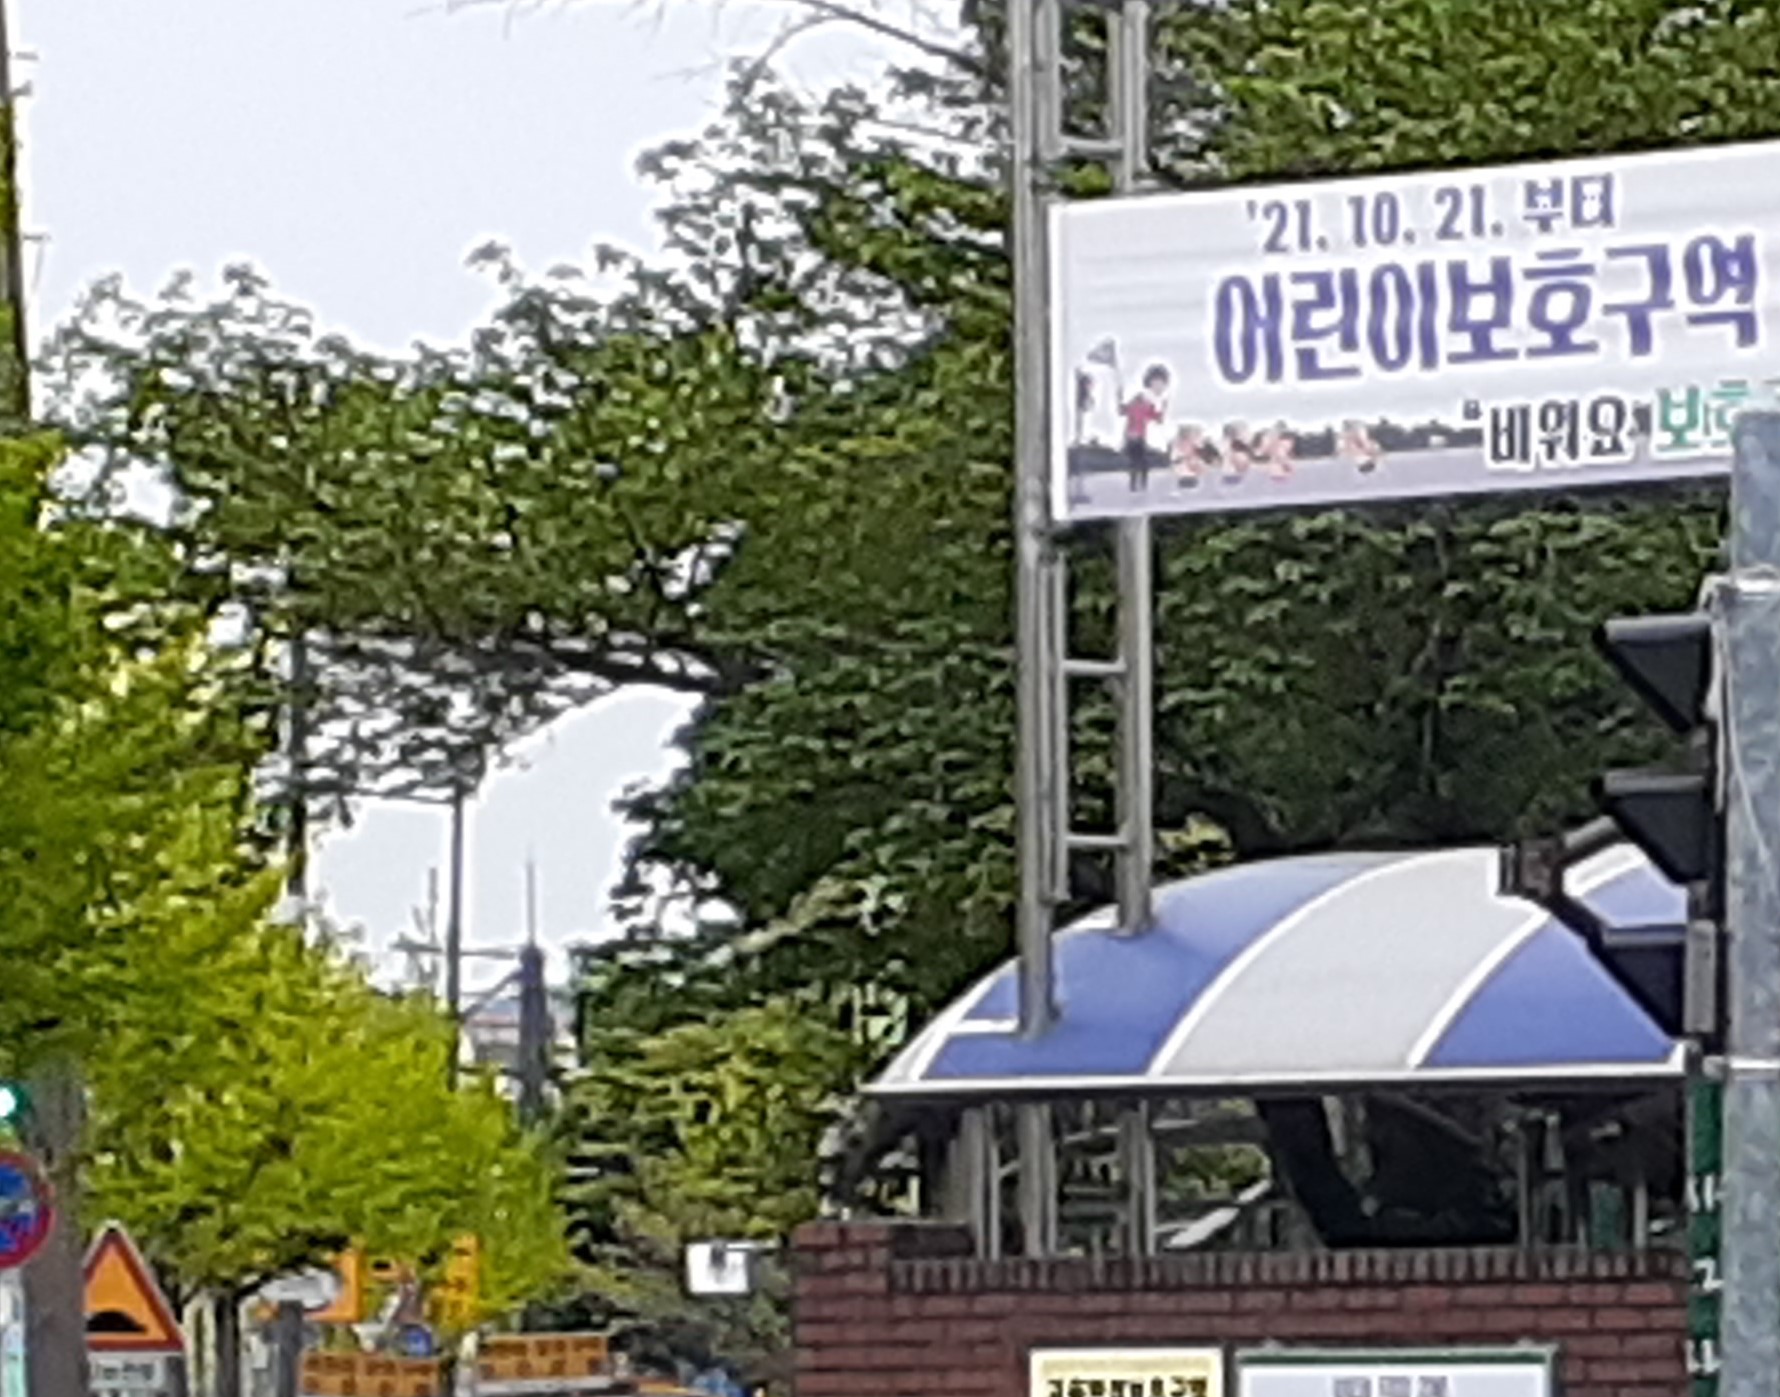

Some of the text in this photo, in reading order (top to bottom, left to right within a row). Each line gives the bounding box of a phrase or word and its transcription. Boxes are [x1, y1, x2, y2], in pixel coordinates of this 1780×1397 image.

[1347, 191, 1416, 248] 10.
[1434, 184, 1503, 241] 21.
[1521, 172, 1617, 234] 부터
[1212, 233, 1758, 386] 어린이보호구역
